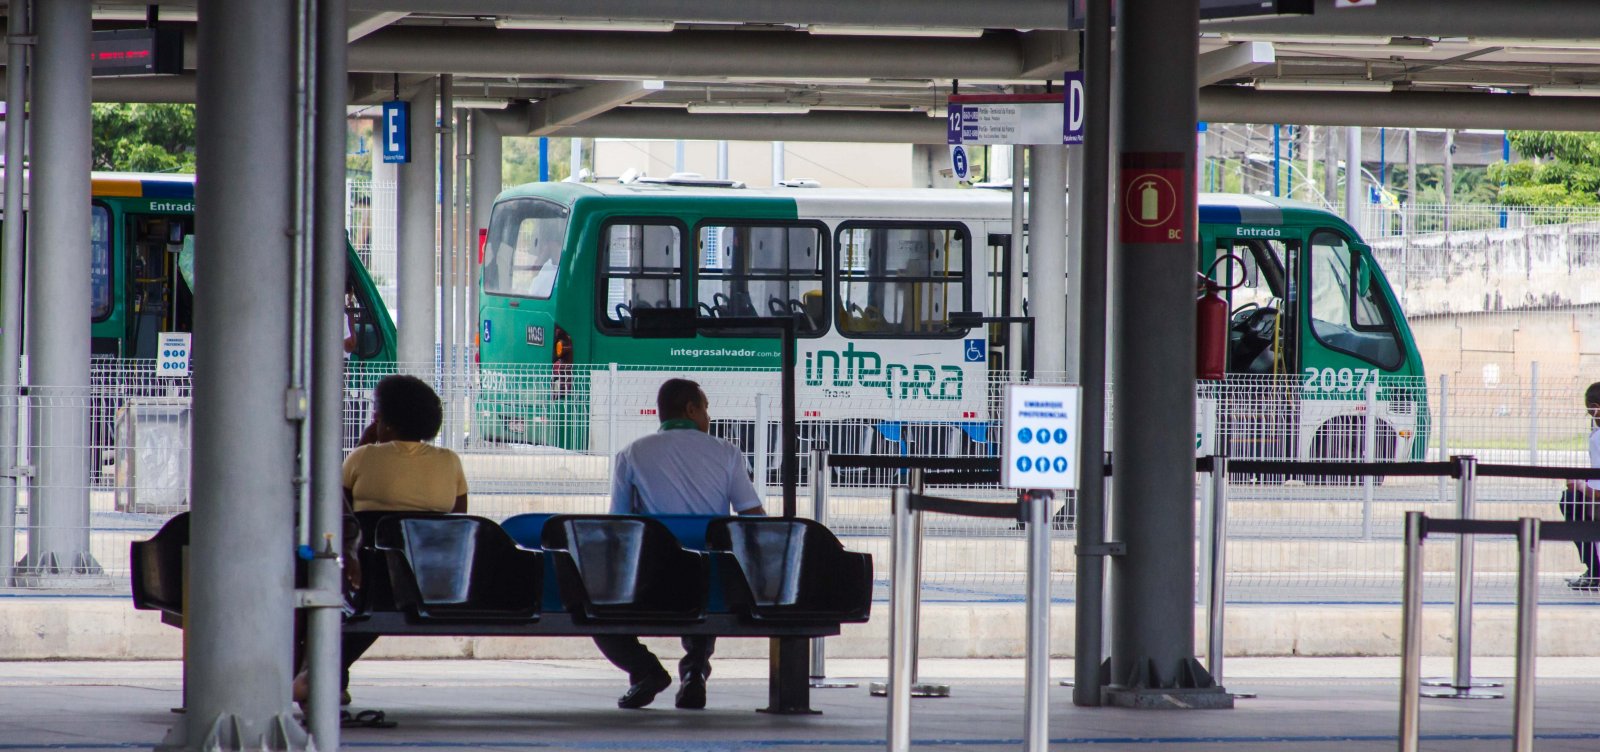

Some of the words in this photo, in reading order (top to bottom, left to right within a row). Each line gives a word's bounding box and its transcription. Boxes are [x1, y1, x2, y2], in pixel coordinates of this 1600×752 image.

[1069, 79, 1084, 131] D
[388, 108, 399, 151] E
[950, 112, 961, 131] 12
[1168, 228, 1182, 239] BC
[1236, 226, 1281, 237] Entrada
[670, 347, 781, 358] integrasalvador.com.br
[1304, 367, 1383, 393] 20971
